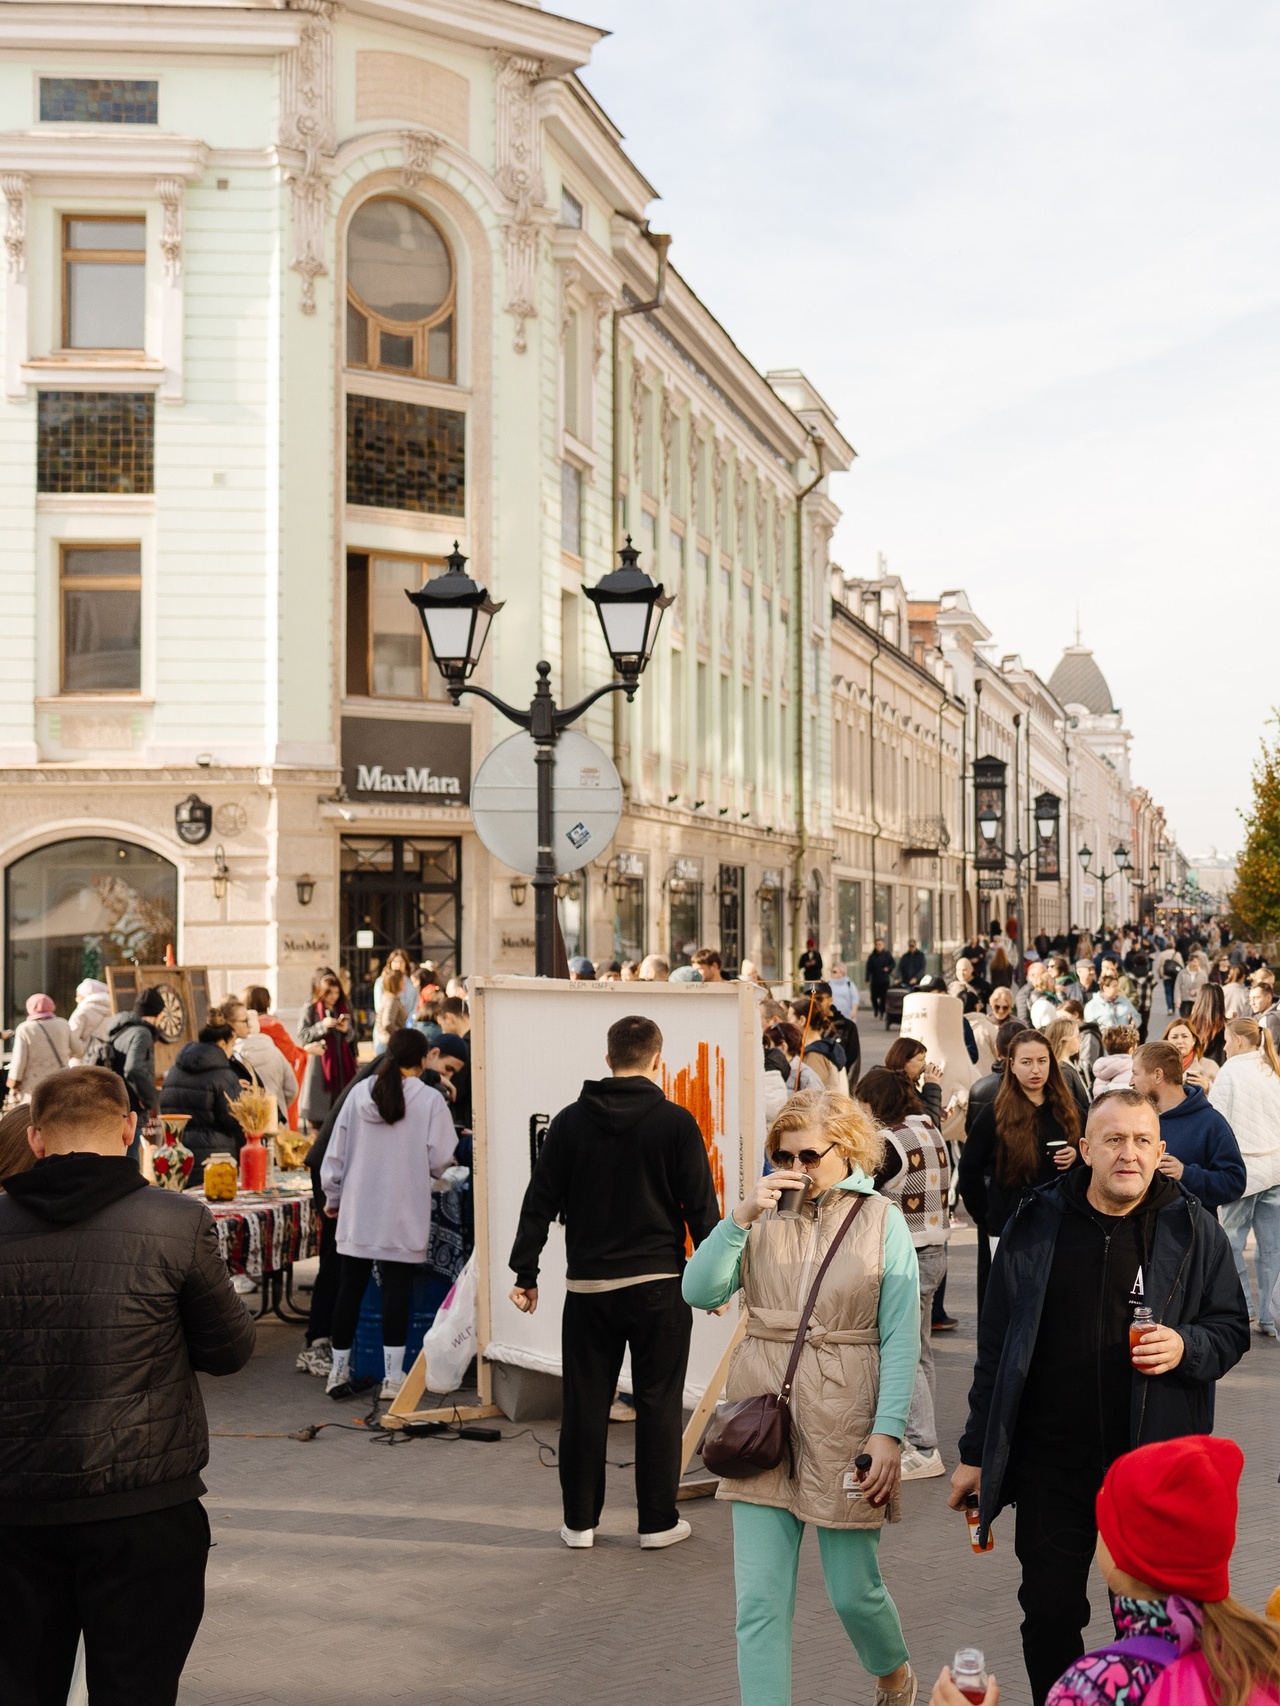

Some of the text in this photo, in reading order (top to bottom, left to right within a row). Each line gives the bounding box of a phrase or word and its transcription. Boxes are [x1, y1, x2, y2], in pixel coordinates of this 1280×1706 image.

[356, 764, 462, 795] MaxMara
[501, 936, 535, 949] MaxMa
[1129, 1264, 1145, 1296] A
